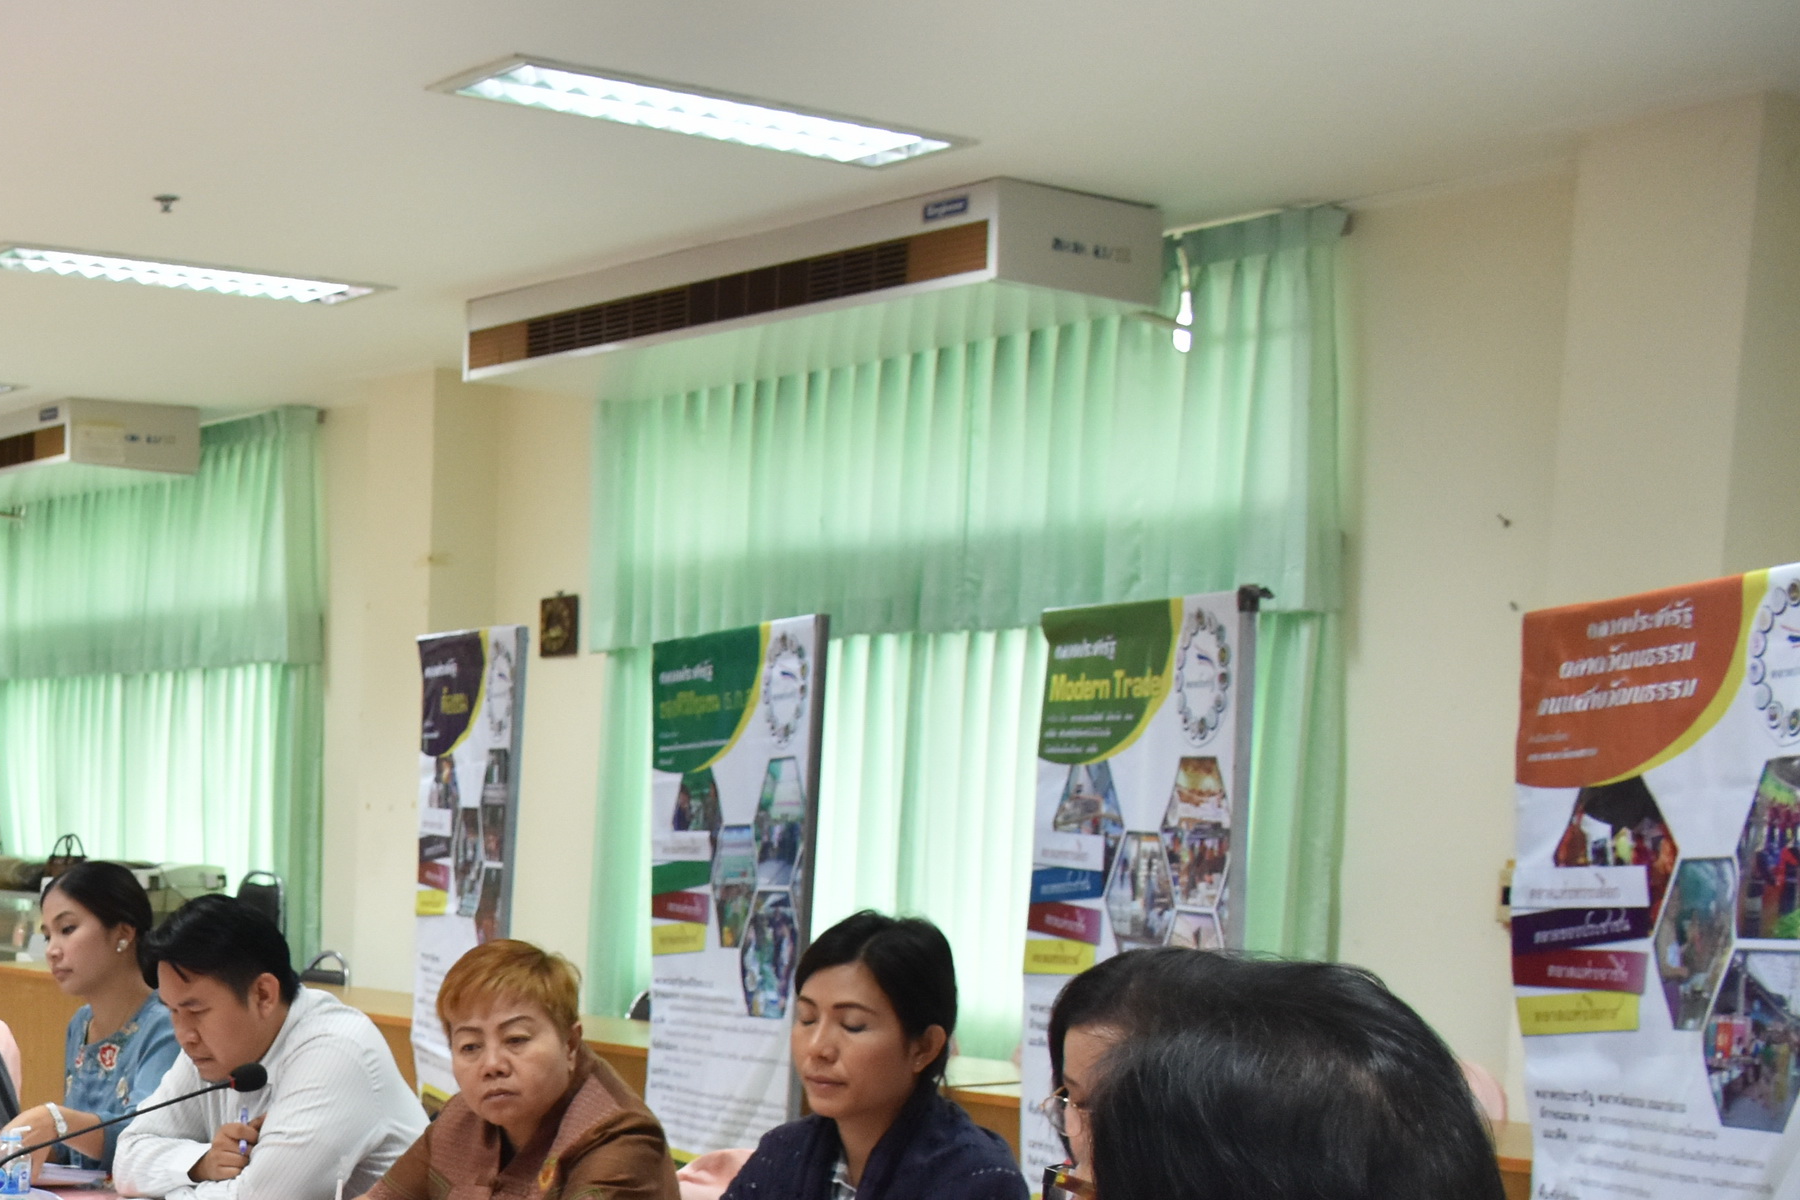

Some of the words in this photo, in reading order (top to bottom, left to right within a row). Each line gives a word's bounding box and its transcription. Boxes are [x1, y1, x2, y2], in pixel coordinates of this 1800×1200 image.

[1559, 641, 1697, 680] ตลาดวัฒนธรรม
[1048, 672, 1111, 703] Modern
[1113, 666, 1163, 699] Trade
